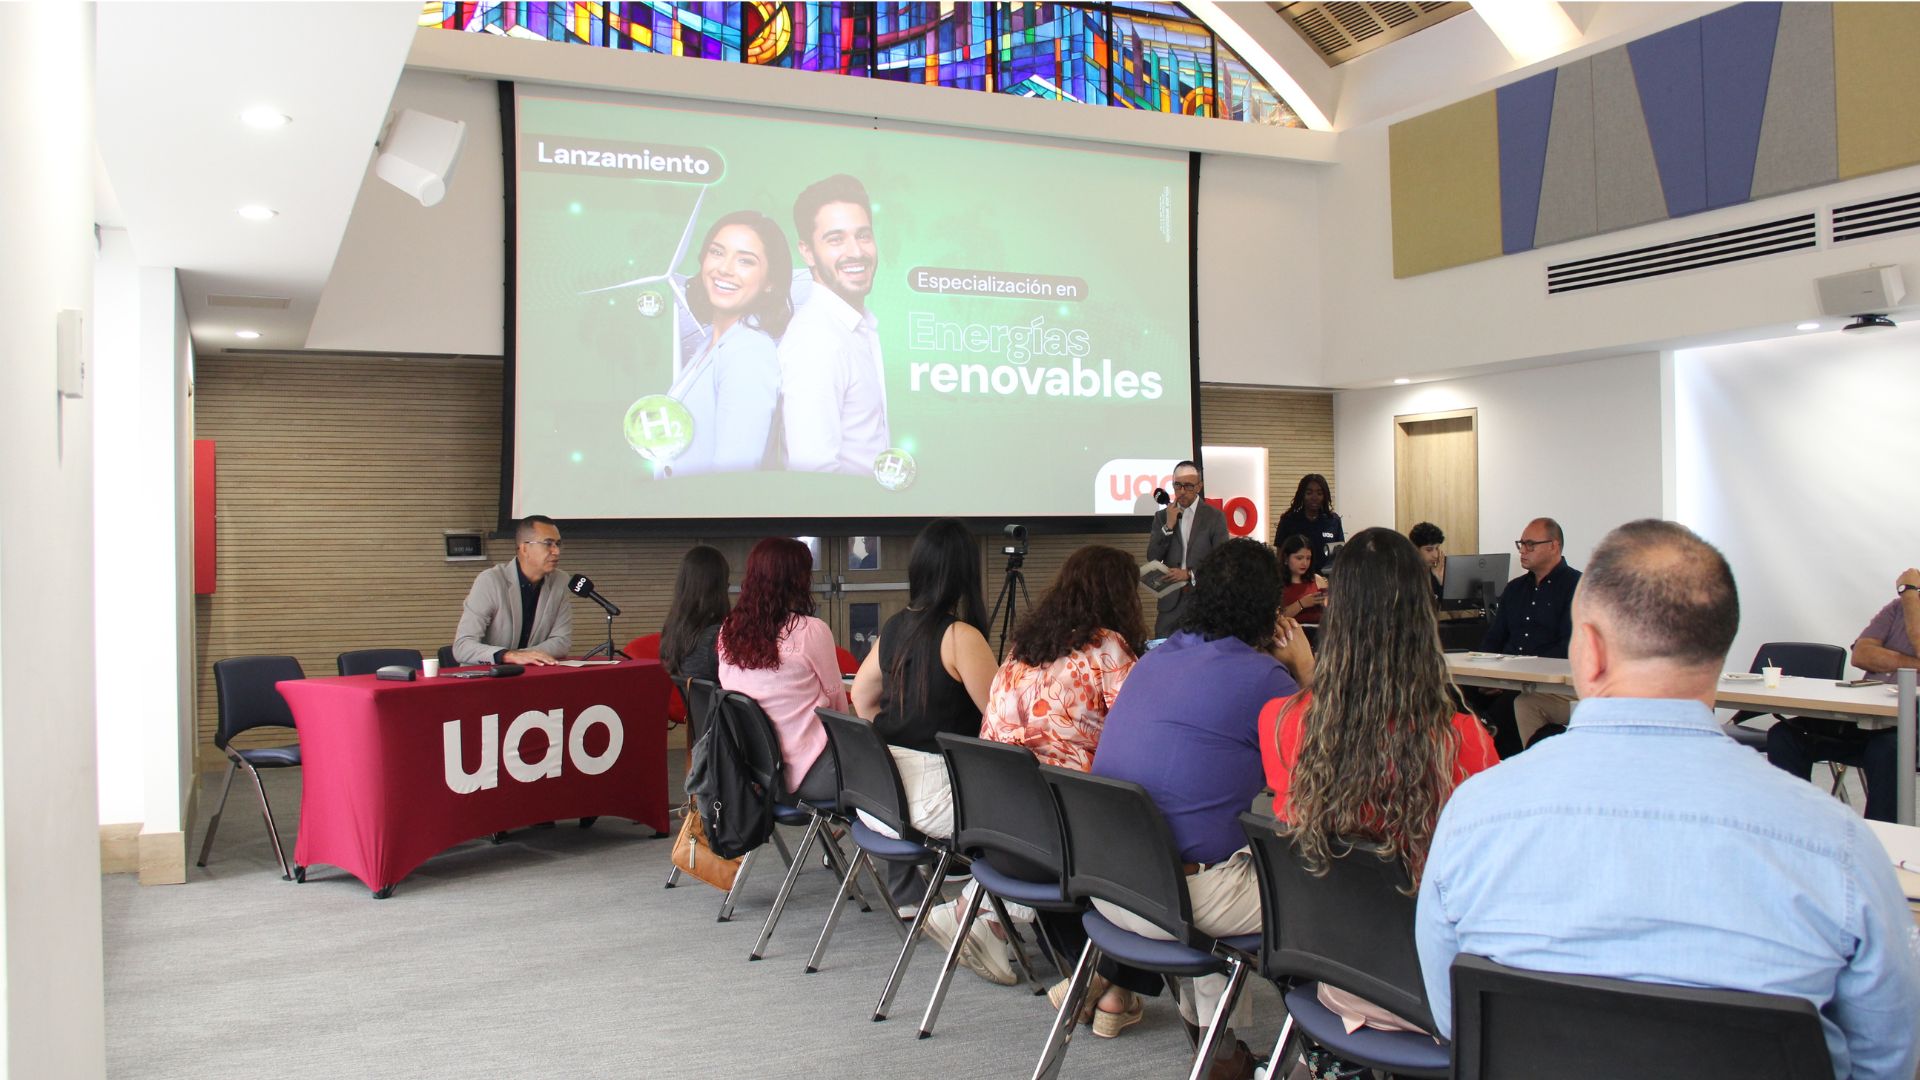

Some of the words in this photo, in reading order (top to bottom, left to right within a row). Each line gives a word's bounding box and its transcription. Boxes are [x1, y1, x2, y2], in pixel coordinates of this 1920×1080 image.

[538, 141, 710, 175] Lanzamiento
[918, 272, 1052, 296] Especialización
[1056, 282, 1077, 297] en
[908, 311, 1090, 365] Energías
[910, 358, 1163, 400] renovables
[574, 577, 586, 593] uao
[443, 704, 625, 795] uao
